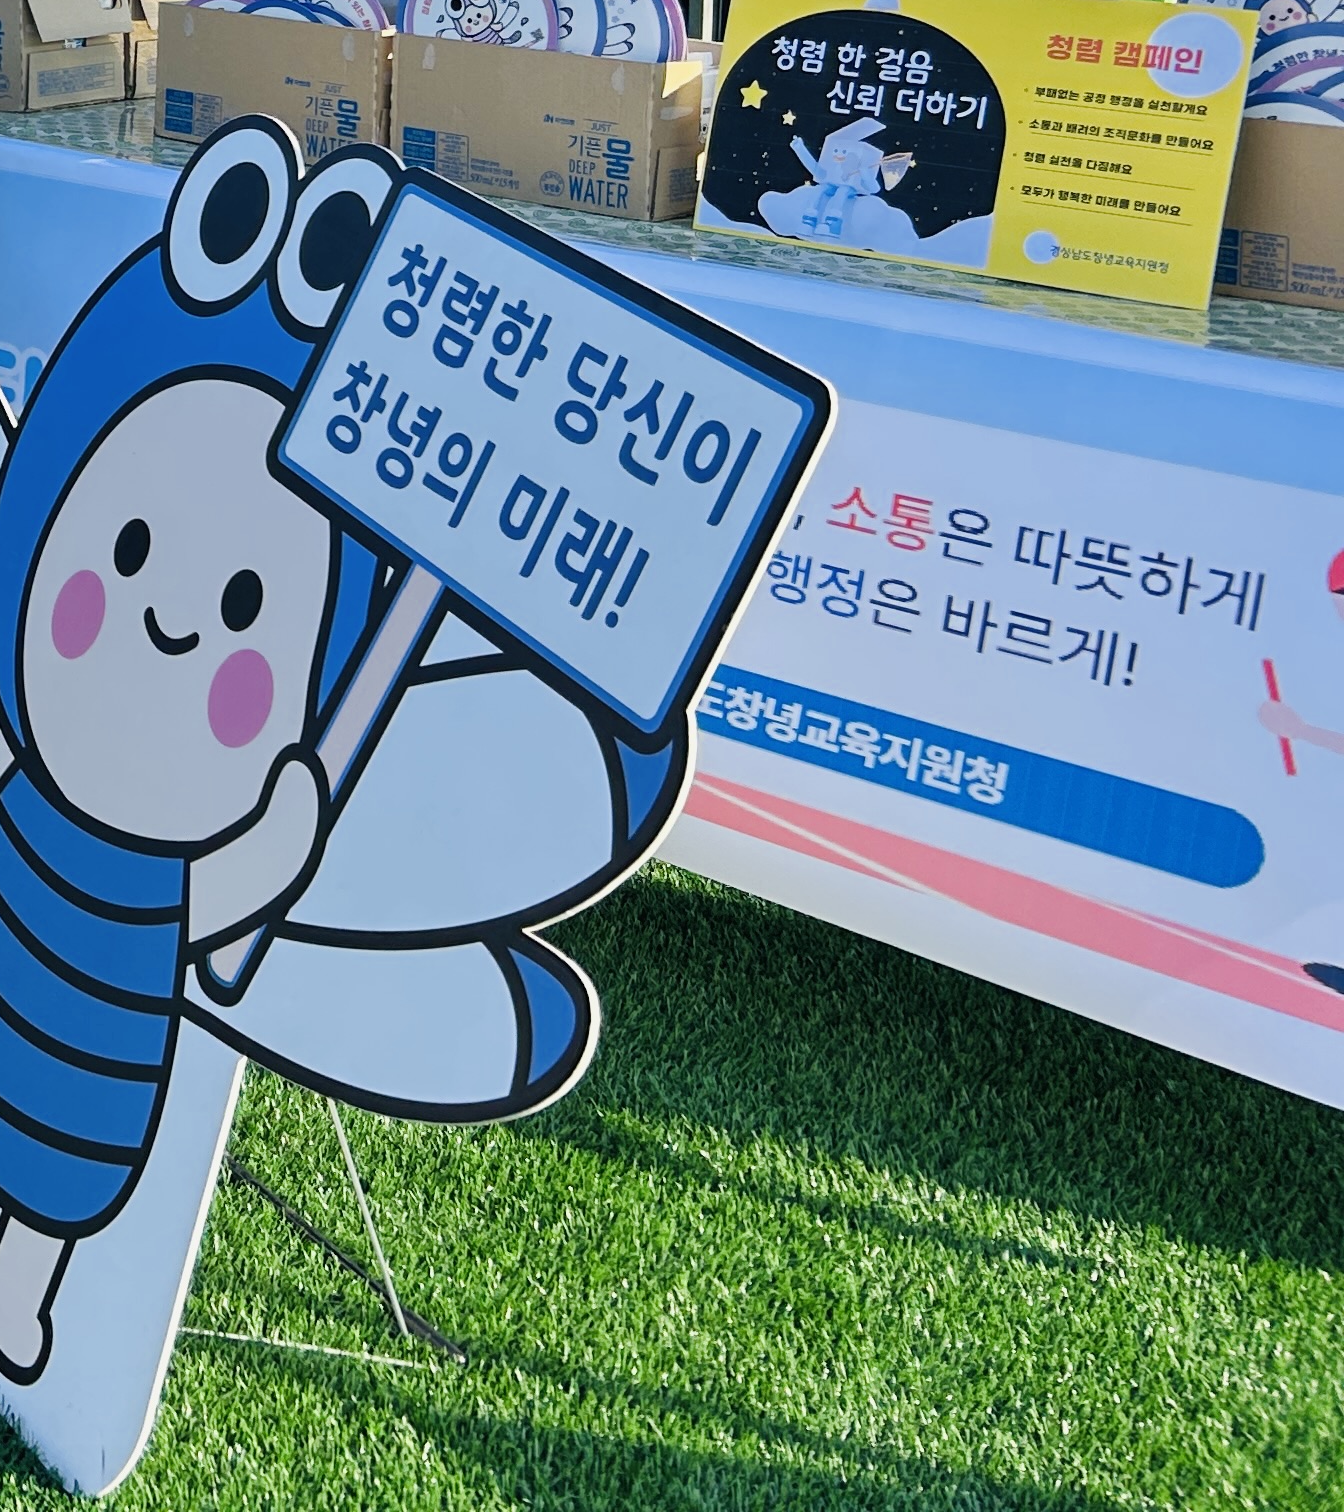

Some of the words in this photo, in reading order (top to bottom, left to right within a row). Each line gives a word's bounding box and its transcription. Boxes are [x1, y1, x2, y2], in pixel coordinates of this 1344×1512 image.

[771, 36, 827, 74] 청렴
[837, 42, 867, 78] 한
[875, 46, 934, 86] 걸음
[1046, 34, 1104, 64] 청렴
[1113, 41, 1204, 75] 캠페인
[305, 96, 362, 139] 기픈물
[826, 79, 885, 117] 신뢰
[895, 88, 989, 130] 더하기
[1034, 85, 1080, 101] 부패없는
[1083, 90, 1107, 104] 공정
[1109, 94, 1145, 109] 행정을
[1148, 99, 1208, 116] 실천할게요
[305, 118, 329, 134] DEEP
[590, 122, 612, 133] JUST
[1028, 118, 1063, 133] 소통과
[1066, 122, 1101, 137] 배려의
[1103, 127, 1163, 145] 조직문화를
[1165, 134, 1214, 151] 만들어요
[567, 134, 635, 181] 기픈물
[568, 158, 596, 175] DEEP
[1023, 151, 1046, 164] 청렴
[1048, 154, 1083, 169] 실천을
[1086, 159, 1133, 175] 다짐해요
[568, 175, 629, 210] WATER
[1020, 184, 1055, 200] 모두가
[1058, 189, 1093, 205] 행복한
[1096, 195, 1130, 210] 미래를
[1133, 200, 1181, 217] 만들어요
[1050, 244, 1170, 274] 경상남도창녕교육지원청
[380, 242, 553, 402] 청렴한
[553, 341, 761, 527] 당신이
[324, 360, 496, 529] 창녕의
[499, 473, 650, 629] 미래!
[825, 485, 994, 567] 소통은
[1013, 524, 1266, 632] 따뜻하게
[767, 549, 921, 633] 행정은
[941, 594, 1140, 689] 바르게!
